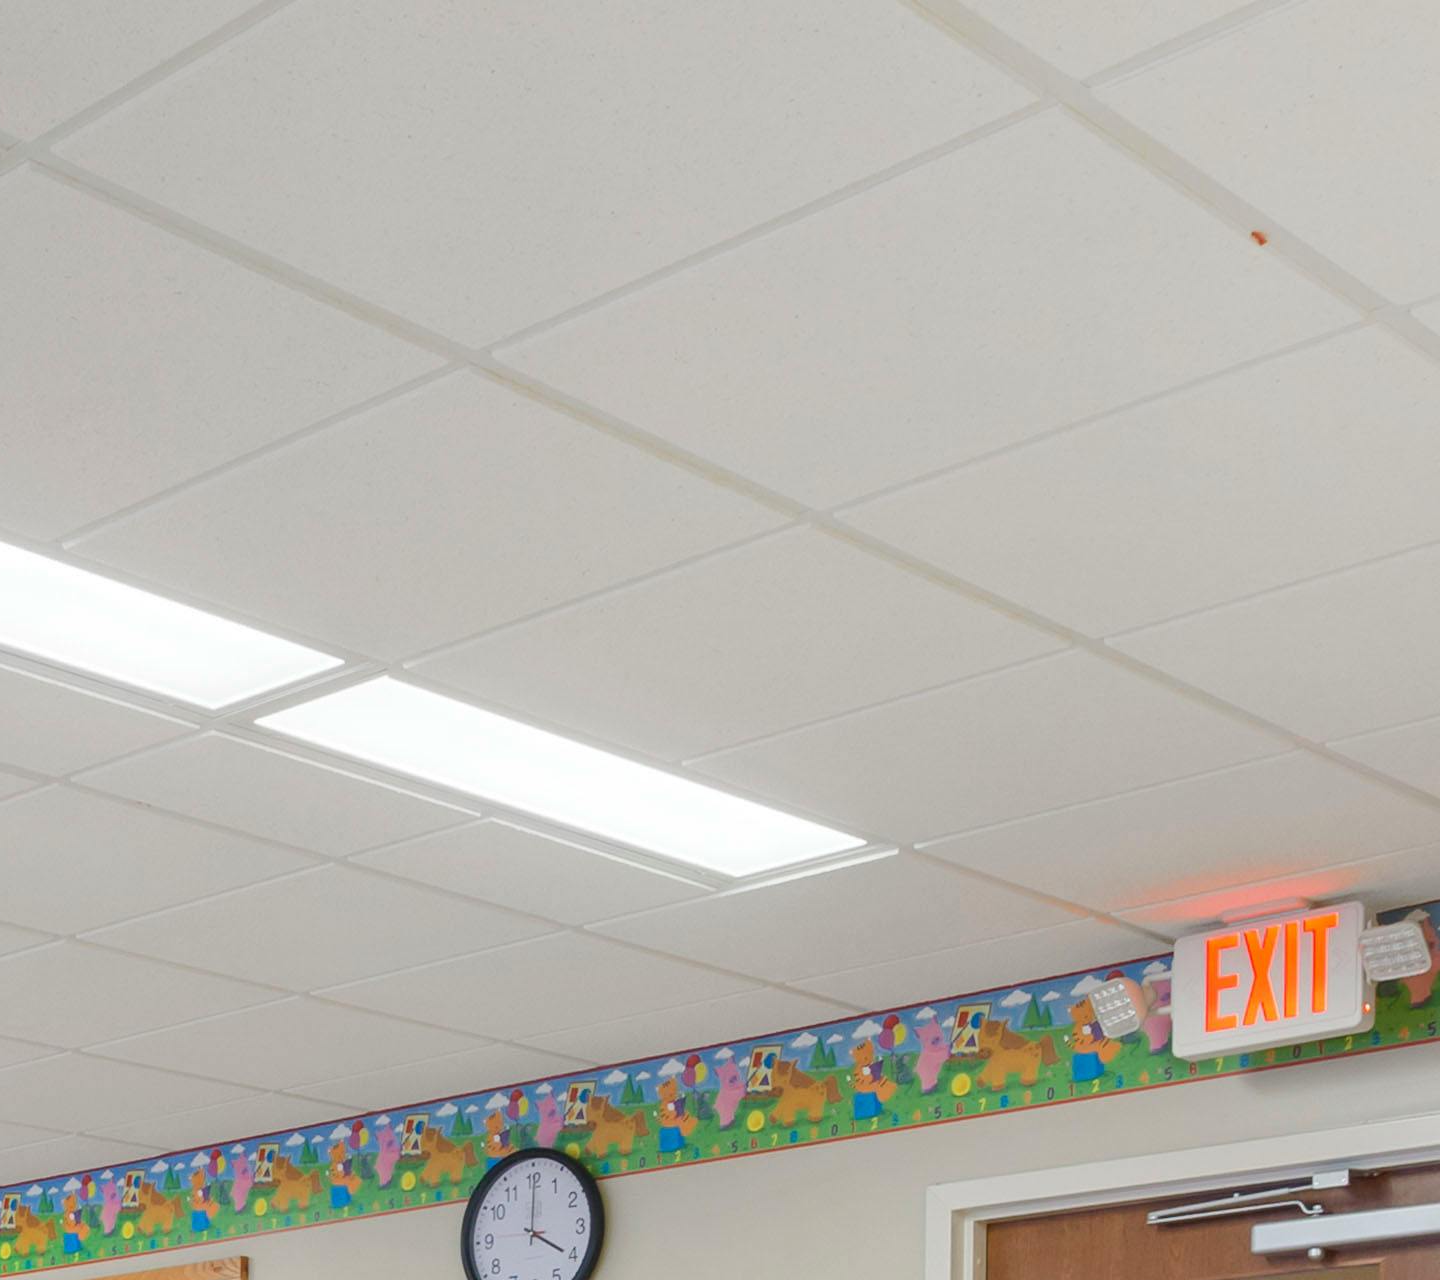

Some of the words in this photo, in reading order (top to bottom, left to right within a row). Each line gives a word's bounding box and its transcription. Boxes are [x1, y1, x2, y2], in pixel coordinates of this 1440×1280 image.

[1205, 911, 1339, 1034] EXIT
[526, 1172, 541, 1189] 12
[552, 1178, 558, 1193] 1
[505, 1186, 518, 1202] 11
[568, 1192, 578, 1208] 2
[491, 1204, 505, 1220] 10
[575, 1218, 585, 1234] 3
[485, 1233, 494, 1250] 9
[568, 1247, 578, 1262] 4
[491, 1258, 500, 1274] 8
